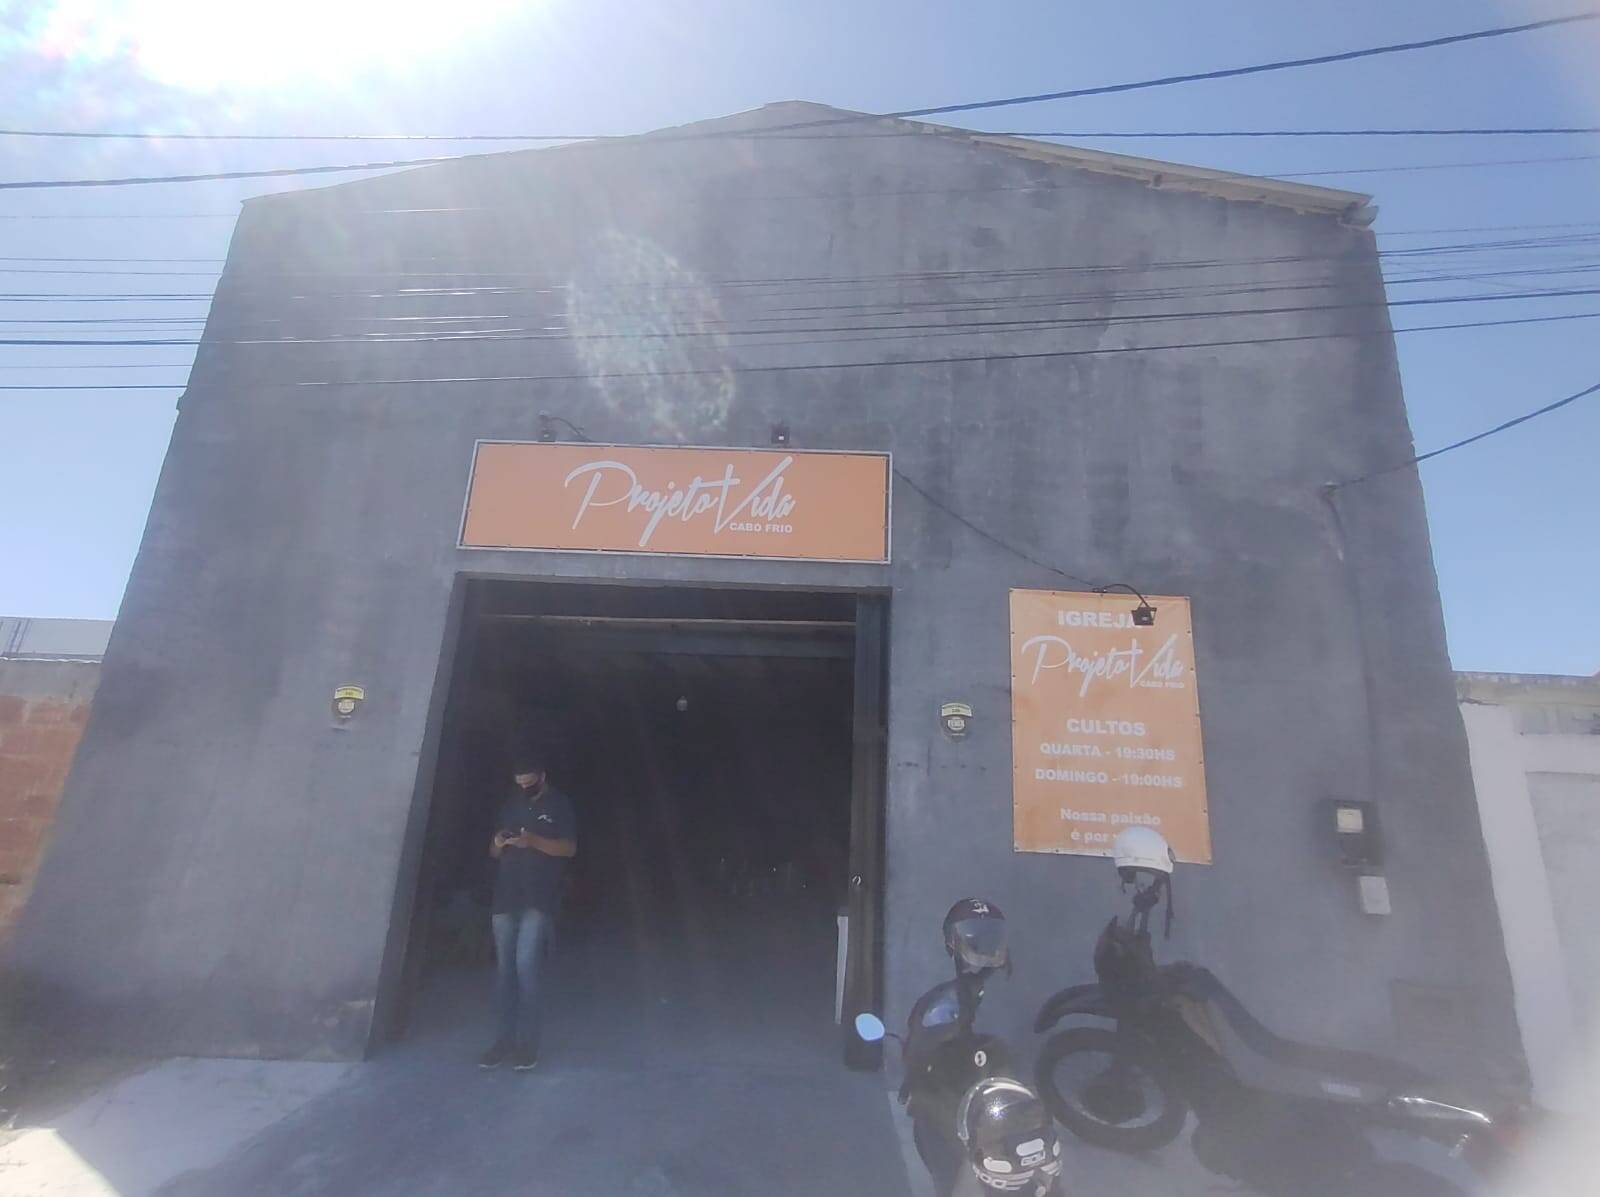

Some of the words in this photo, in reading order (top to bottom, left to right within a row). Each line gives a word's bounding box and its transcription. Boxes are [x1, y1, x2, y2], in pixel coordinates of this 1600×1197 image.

[564, 460, 719, 547] Projeto
[714, 456, 796, 534] Vida
[729, 522, 762, 532] CABO
[765, 524, 793, 533] FRIO
[1021, 635, 1131, 697] Projeto
[1129, 633, 1184, 688] Vida
[1066, 718, 1146, 737] CULTOS
[1040, 742, 1102, 758] QUARTA
[1035, 768, 1108, 784] DOMINGO
[1084, 832, 1109, 844] por
